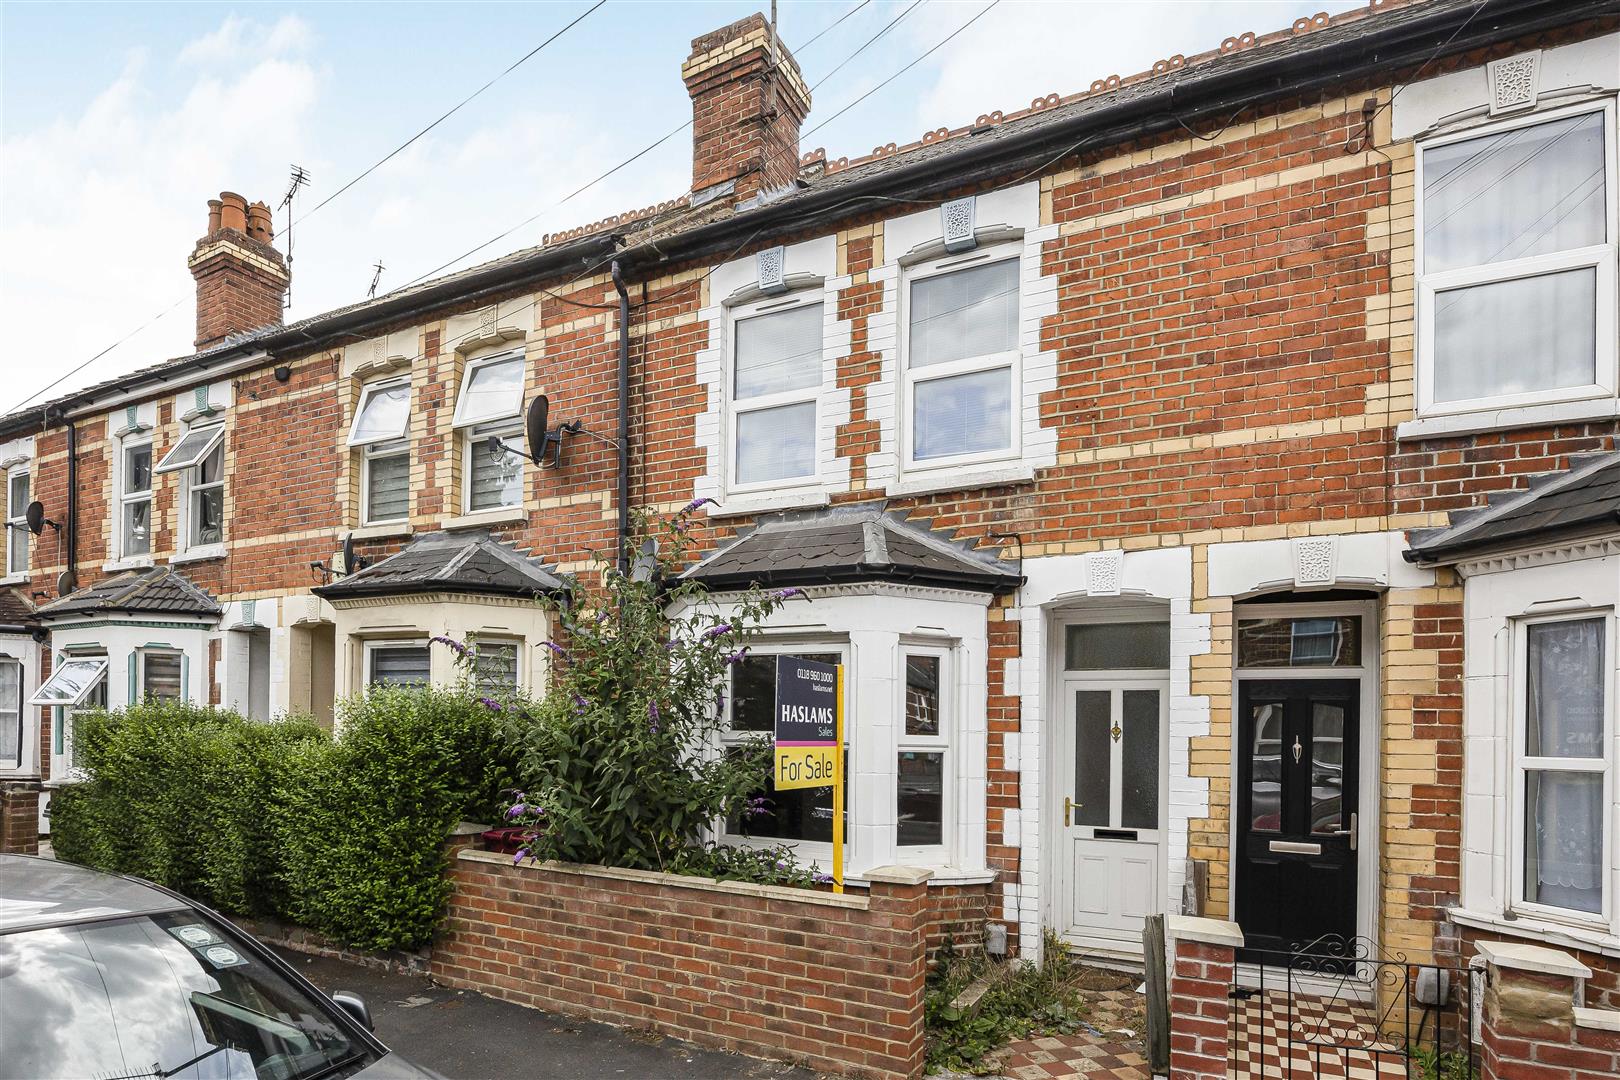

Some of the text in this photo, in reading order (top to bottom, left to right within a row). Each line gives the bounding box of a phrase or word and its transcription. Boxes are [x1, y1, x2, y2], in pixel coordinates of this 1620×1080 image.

[797, 668, 833, 683] 0118 960 1000
[781, 704, 833, 724] HASLAMS
[818, 726, 833, 737] Sales
[780, 753, 833, 782] For Sale
